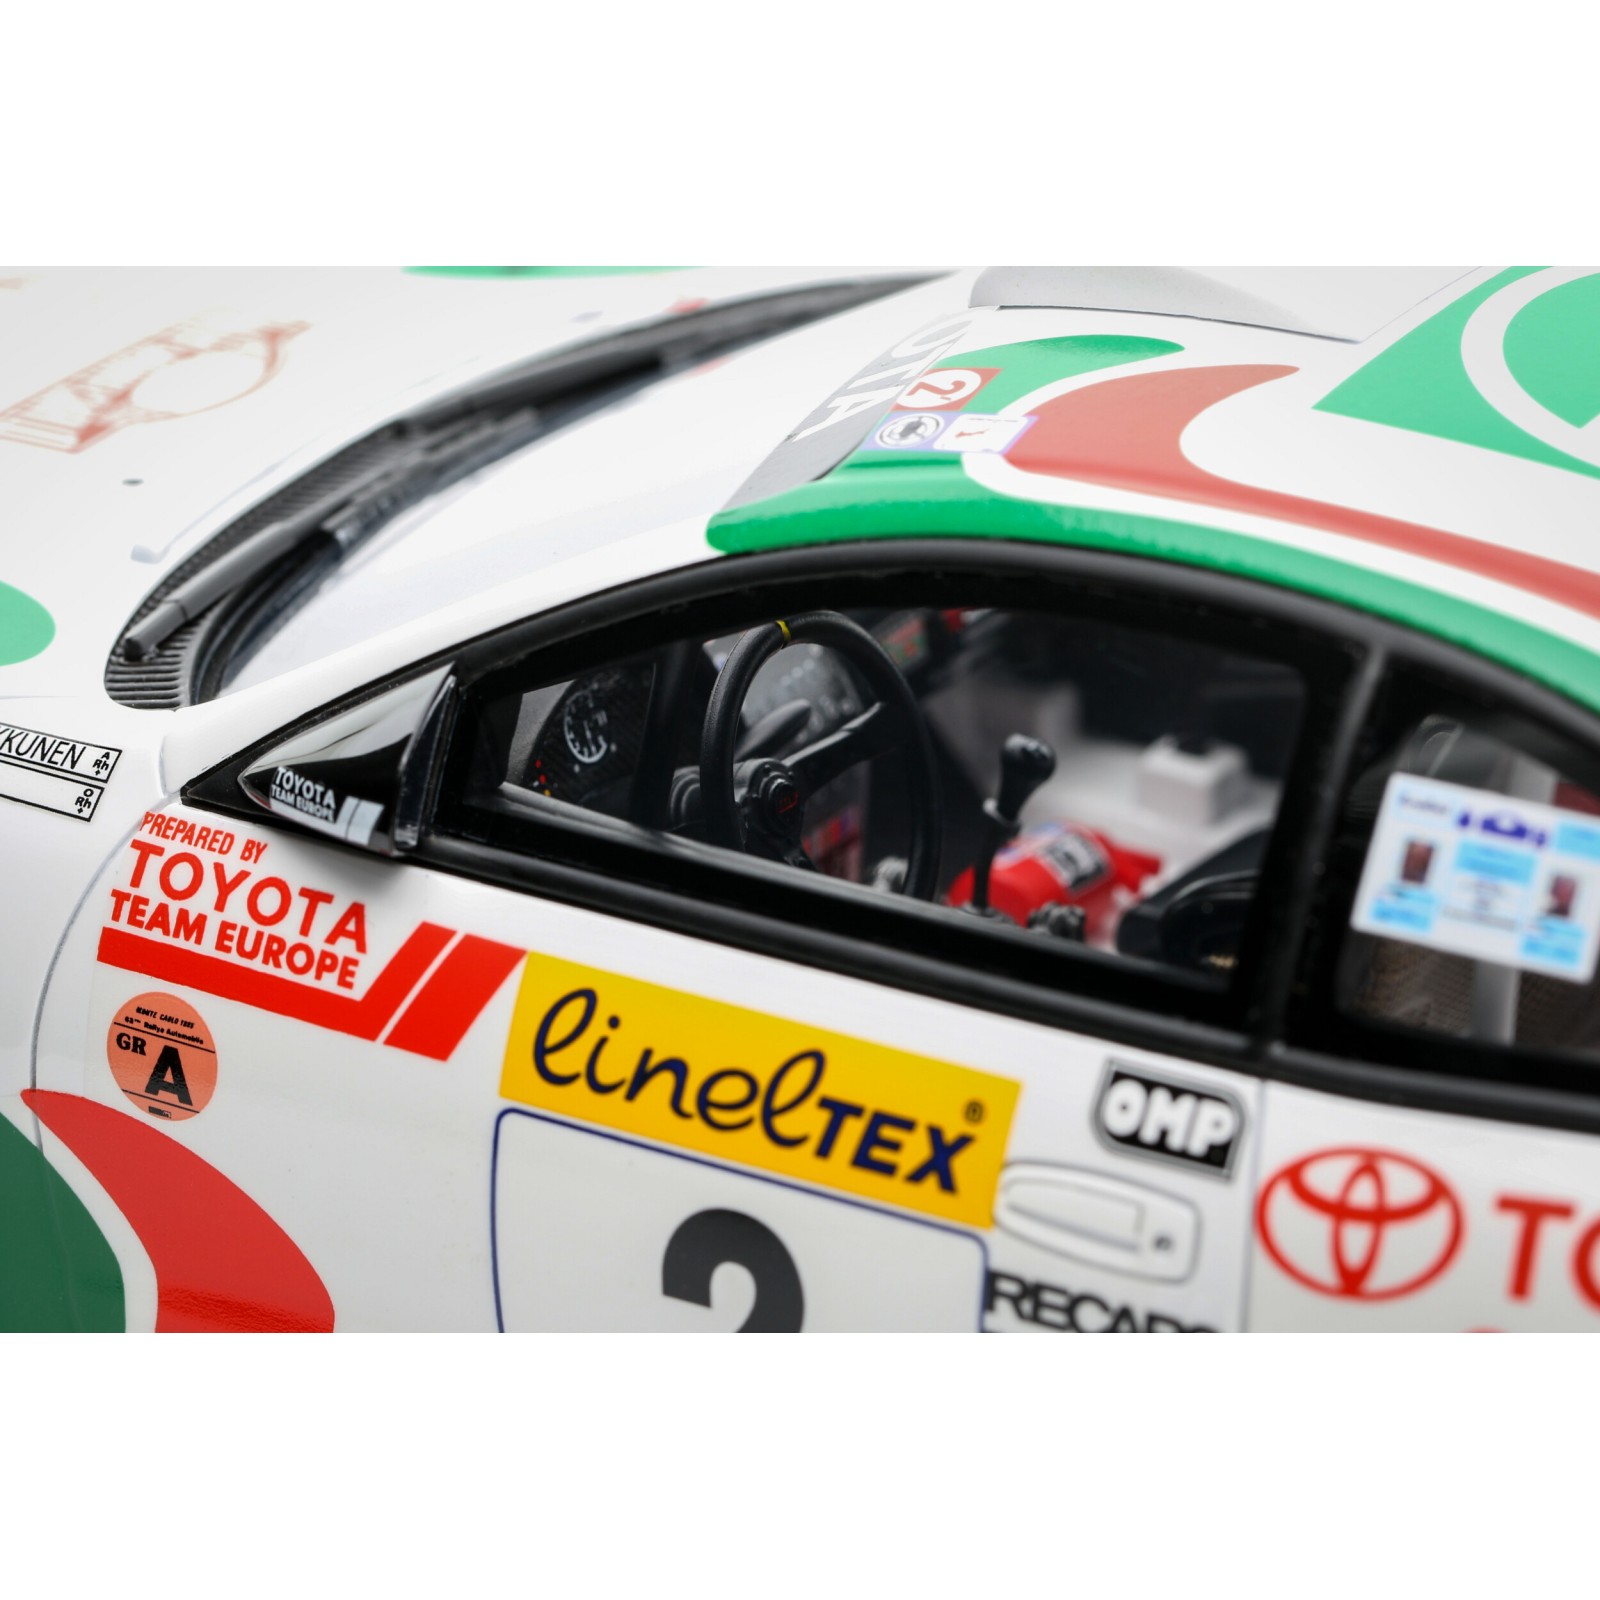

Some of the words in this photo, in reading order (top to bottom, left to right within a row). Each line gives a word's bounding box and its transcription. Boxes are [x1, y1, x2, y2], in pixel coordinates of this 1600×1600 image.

[0, 727, 86, 769] KUNEN
[92, 759, 109, 771] Rh
[101, 752, 110, 760] A
[75, 796, 92, 809] Rh
[271, 784, 295, 806] TEAM
[296, 796, 335, 824] EUROPE
[275, 766, 336, 809] TOYOTA
[140, 812, 234, 855] PREPARED
[240, 838, 268, 864] BY
[129, 839, 367, 954] TOYOTA
[110, 888, 207, 944] TEAM
[214, 921, 360, 990] EUROPE
[136, 1006, 158, 1019] MONTE
[143, 1021, 165, 1034] Rallye
[116, 1032, 147, 1056] GR
[144, 1045, 193, 1106] A
[1101, 1077, 1237, 1157] OMP
[662, 1208, 805, 1333] 2
[1496, 1195, 1600, 1318] T
